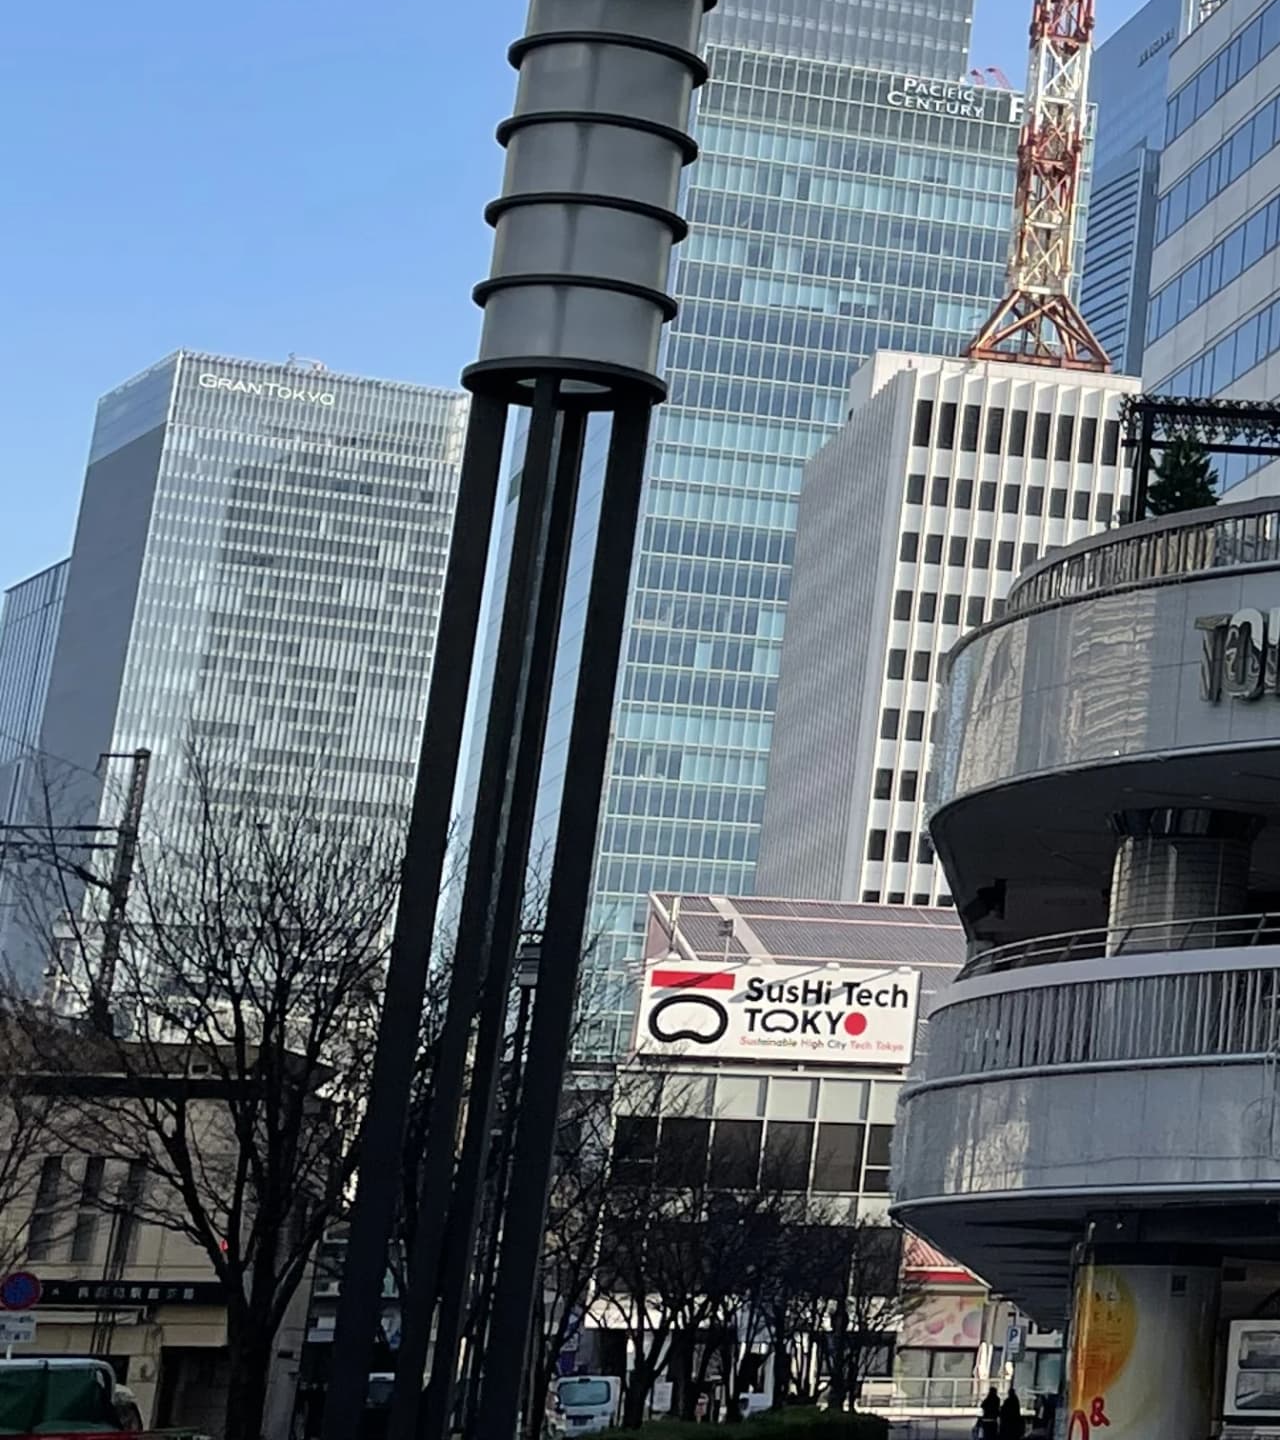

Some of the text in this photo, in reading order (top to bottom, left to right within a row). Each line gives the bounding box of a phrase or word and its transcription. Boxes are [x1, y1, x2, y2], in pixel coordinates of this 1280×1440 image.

[903, 77, 976, 102] PACIFIC
[886, 91, 985, 119] CENTURY
[744, 976, 909, 1009] SusHi Tech
